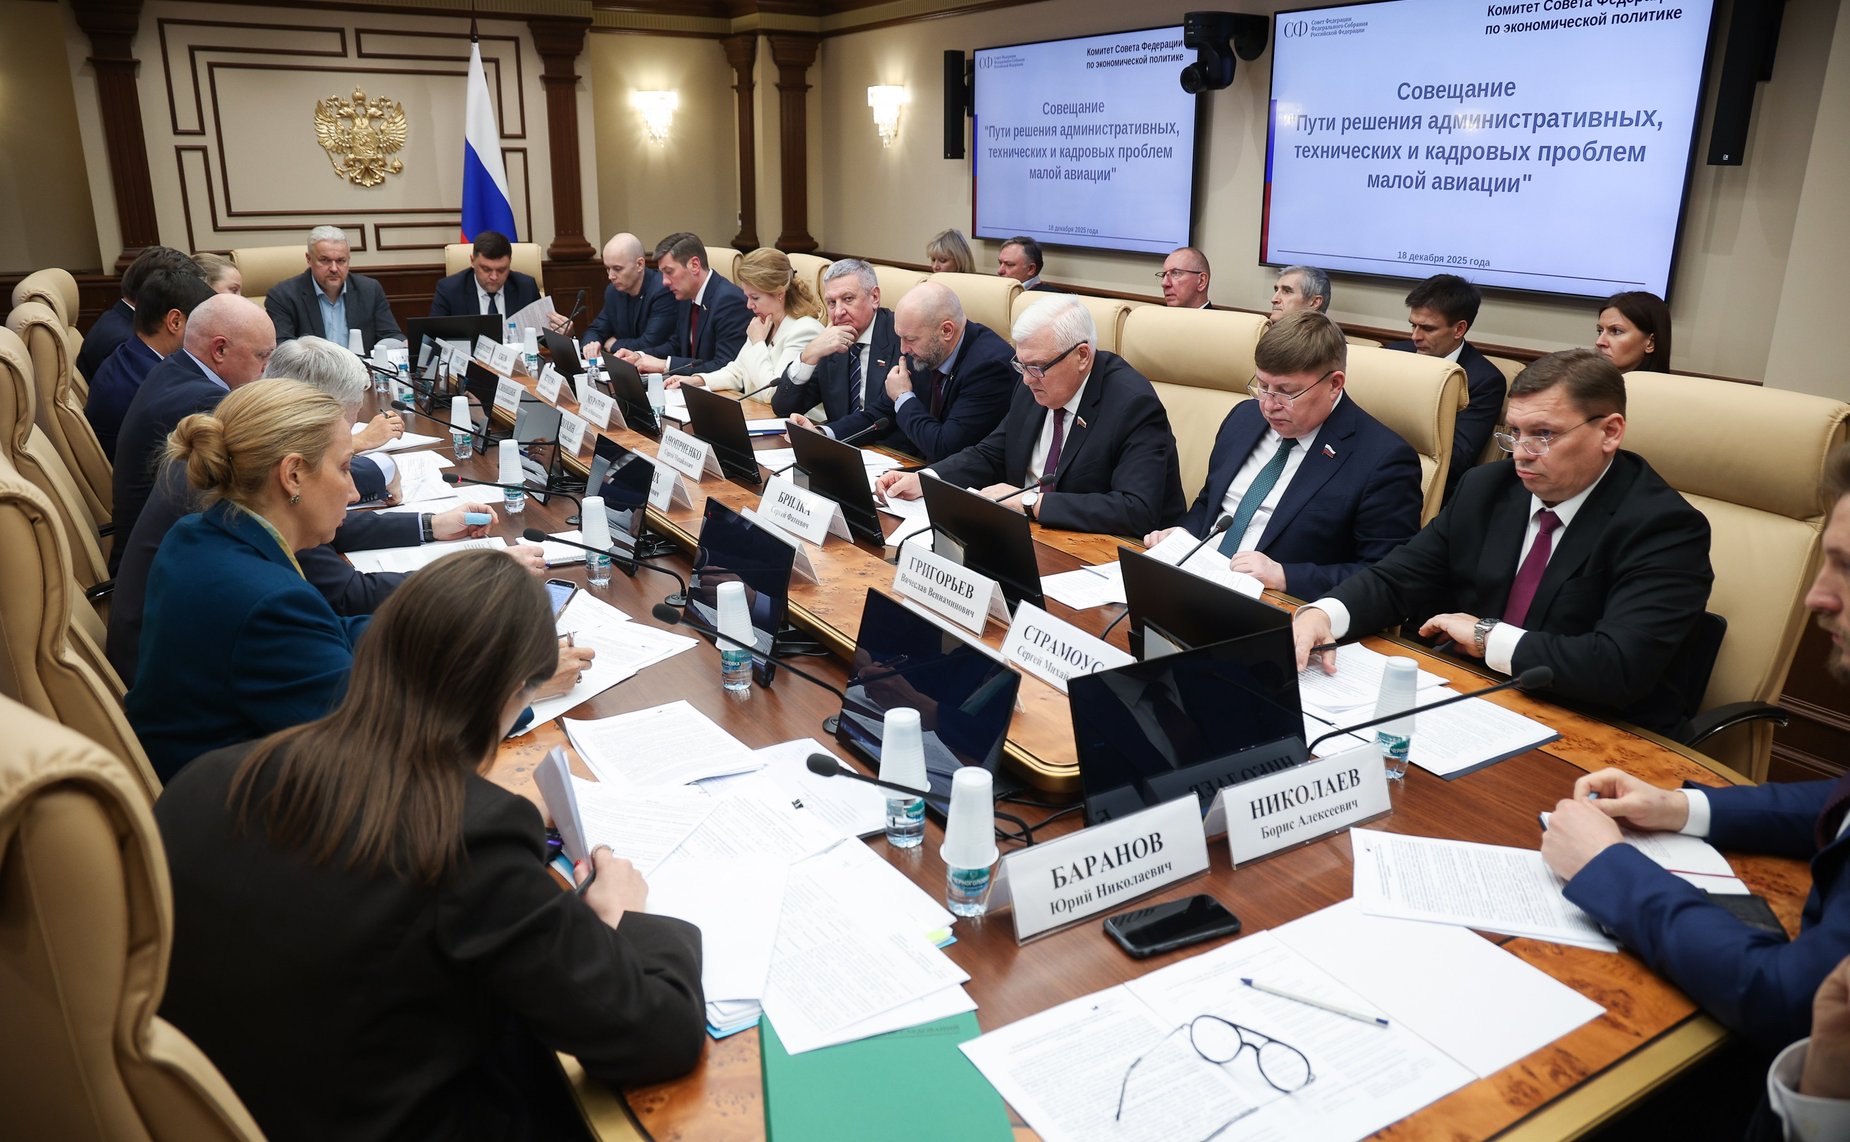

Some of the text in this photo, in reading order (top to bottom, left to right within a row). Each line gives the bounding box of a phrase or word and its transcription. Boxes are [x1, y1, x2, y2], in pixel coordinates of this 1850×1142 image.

[1487, 1, 1540, 17] Комитет
[1543, 0, 1593, 12] Совета
[1485, 8, 1683, 35] по экономической политике
[1086, 40, 1183, 57] Комитет Совета Федерации
[1086, 53, 1184, 70] по экономической политике
[1397, 80, 1516, 104] Совещание
[1042, 101, 1105, 118] Совещание
[1341, 114, 1422, 135] решения
[1427, 109, 1663, 135] административных,
[984, 122, 1180, 141] "Пути решения административных,
[988, 143, 1173, 162] технических и кадровых проблем
[1294, 140, 1647, 167] технических и кадровых проблем
[1029, 165, 1117, 184] малой авиации"
[1367, 170, 1532, 197] малой авиации"
[1397, 251, 1490, 268] 18 декабря 2025 года
[909, 556, 974, 599] ГРИГОРЬЕВ
[900, 572, 975, 618] Вячеслав Вениаминович
[1017, 645, 1042, 666] Сергей
[1249, 768, 1361, 820] НИКОЛАЕВ
[1261, 799, 1359, 840] Борис Алексеевич
[1050, 832, 1164, 890] БАРАНОВ
[1050, 861, 1172, 915] Юрий Николаевич
